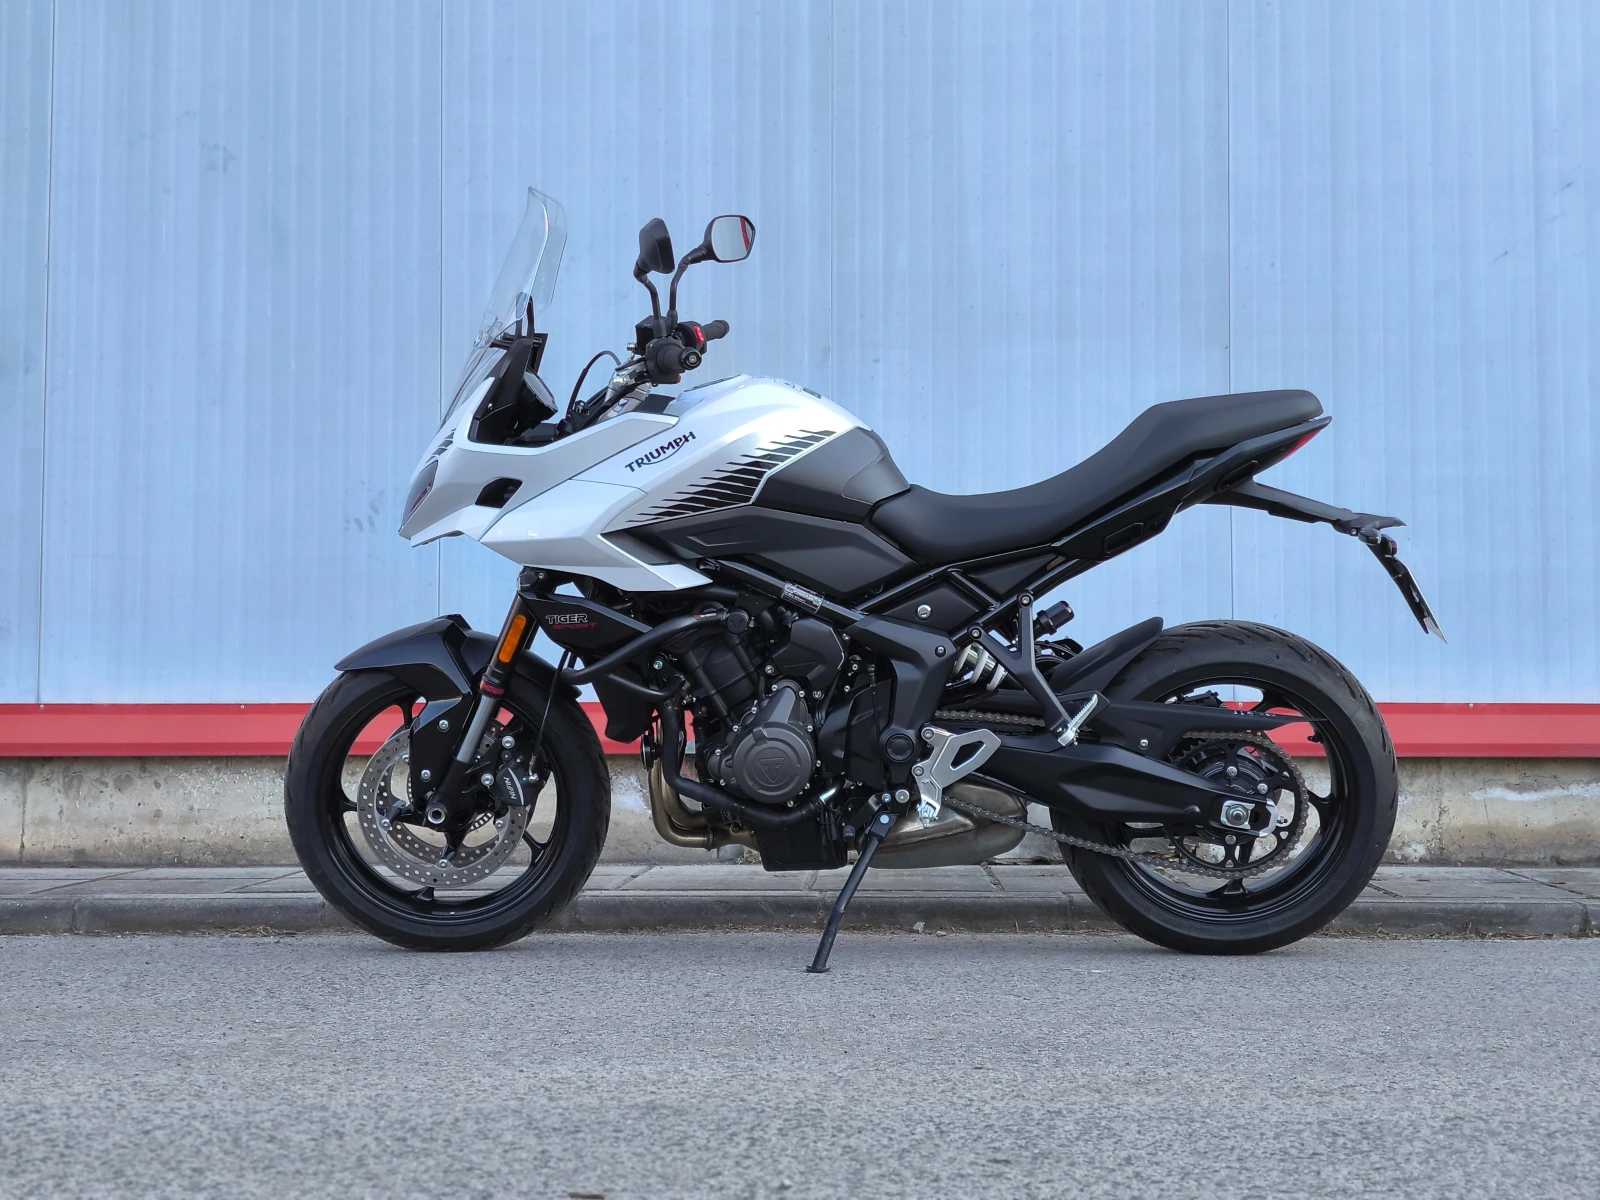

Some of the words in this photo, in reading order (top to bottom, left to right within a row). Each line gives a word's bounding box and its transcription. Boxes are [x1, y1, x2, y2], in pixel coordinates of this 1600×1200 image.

[625, 431, 696, 472] TRIUMPH
[545, 613, 588, 624] TIGER
[552, 622, 599, 630] SPORT
